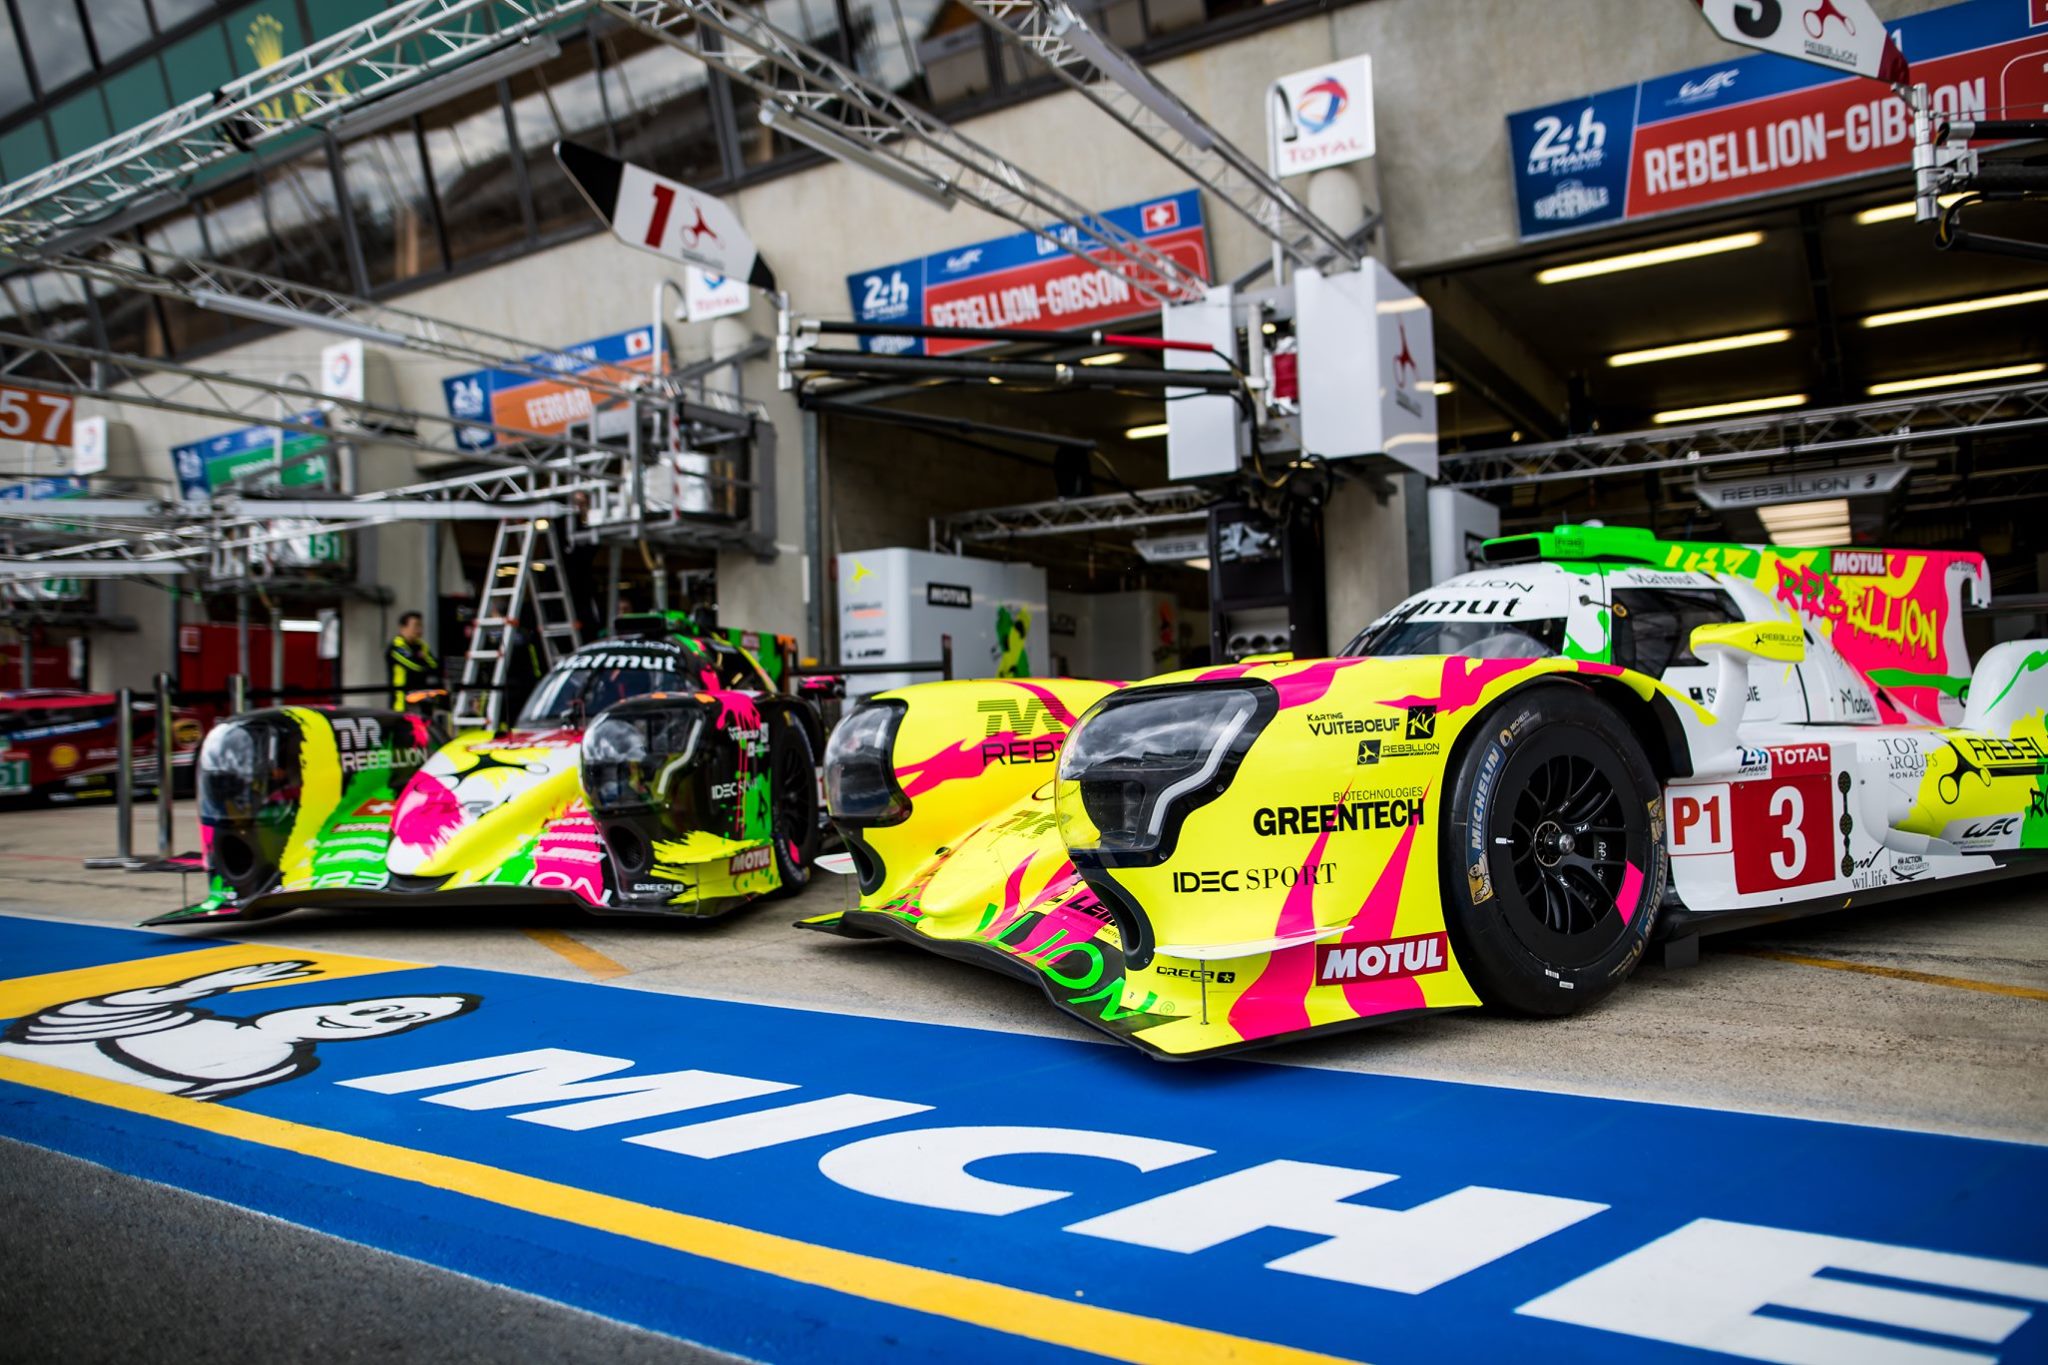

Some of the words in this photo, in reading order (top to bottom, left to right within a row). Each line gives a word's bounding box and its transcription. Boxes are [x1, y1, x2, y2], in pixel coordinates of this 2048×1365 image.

[1287, 138, 1367, 164] TOTAL
[644, 182, 677, 249] 1
[0, 389, 71, 441] 57
[1721, 476, 1850, 504] REBELLION
[1832, 551, 1886, 575] MOTUL
[1308, 717, 1400, 737] VUITEBOEUF
[982, 740, 1064, 767] REB
[1382, 742, 1440, 753] REBELLION
[1770, 746, 1828, 766] TOTAL
[1878, 737, 1919, 756] TOP
[341, 748, 431, 773] REBELLION
[1748, 766, 1768, 774] MANS
[1888, 770, 1925, 779] MONACO
[711, 782, 738, 800] IDEC
[1333, 786, 1423, 802] BIOTECHNOLOGIES
[1470, 745, 1501, 851] MICHELIN
[1253, 798, 1425, 837] GREENTECH
[1671, 795, 1722, 846] P1
[1961, 817, 2019, 839] WEC
[1768, 785, 1808, 881] 3
[730, 847, 771, 874] MOTUL
[1173, 869, 1240, 893] IDEC
[1246, 862, 1338, 891] SPORT
[1321, 937, 1444, 981] MOTUL
[1156, 965, 1215, 980] ORECA
[333, 1047, 2048, 1365] MICHE
